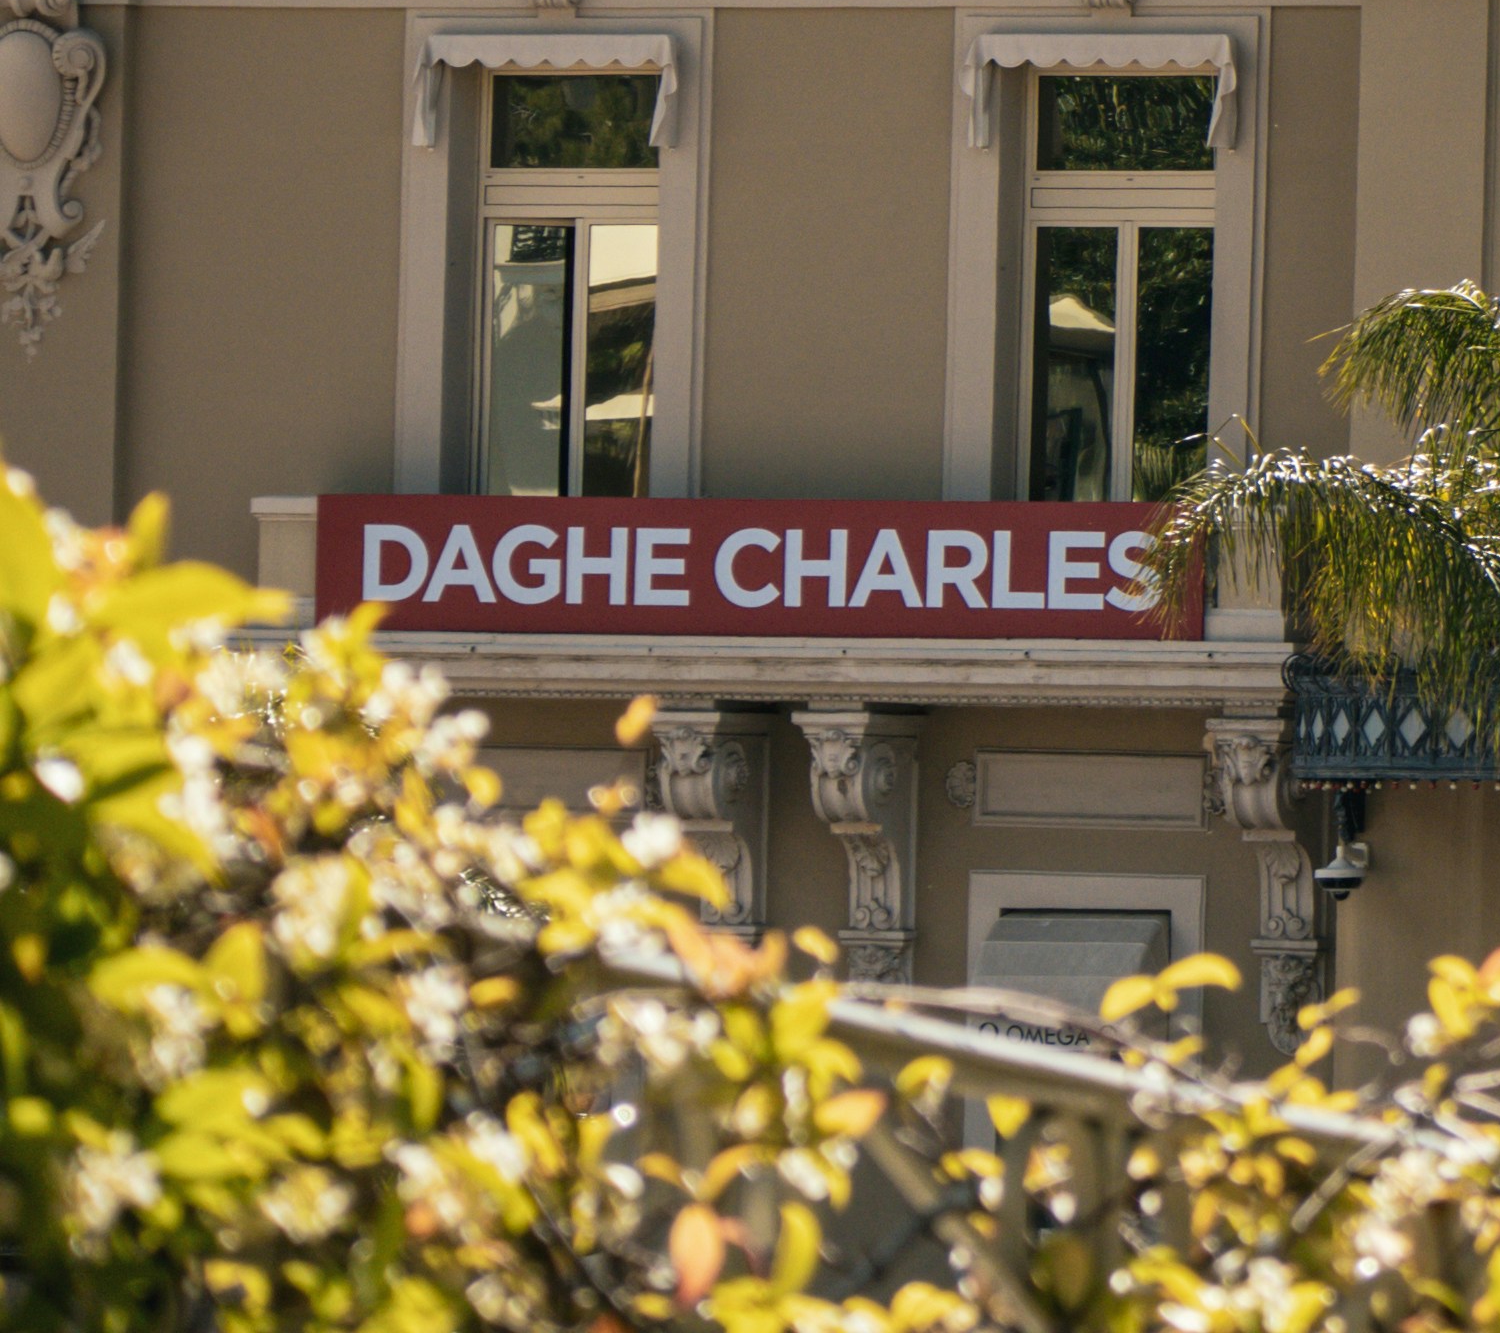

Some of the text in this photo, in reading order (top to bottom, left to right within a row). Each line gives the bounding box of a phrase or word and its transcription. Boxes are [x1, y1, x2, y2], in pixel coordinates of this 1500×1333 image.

[363, 524, 1163, 612] DAGHE CHARLES
[1006, 1024, 1090, 1046] OMEGA
